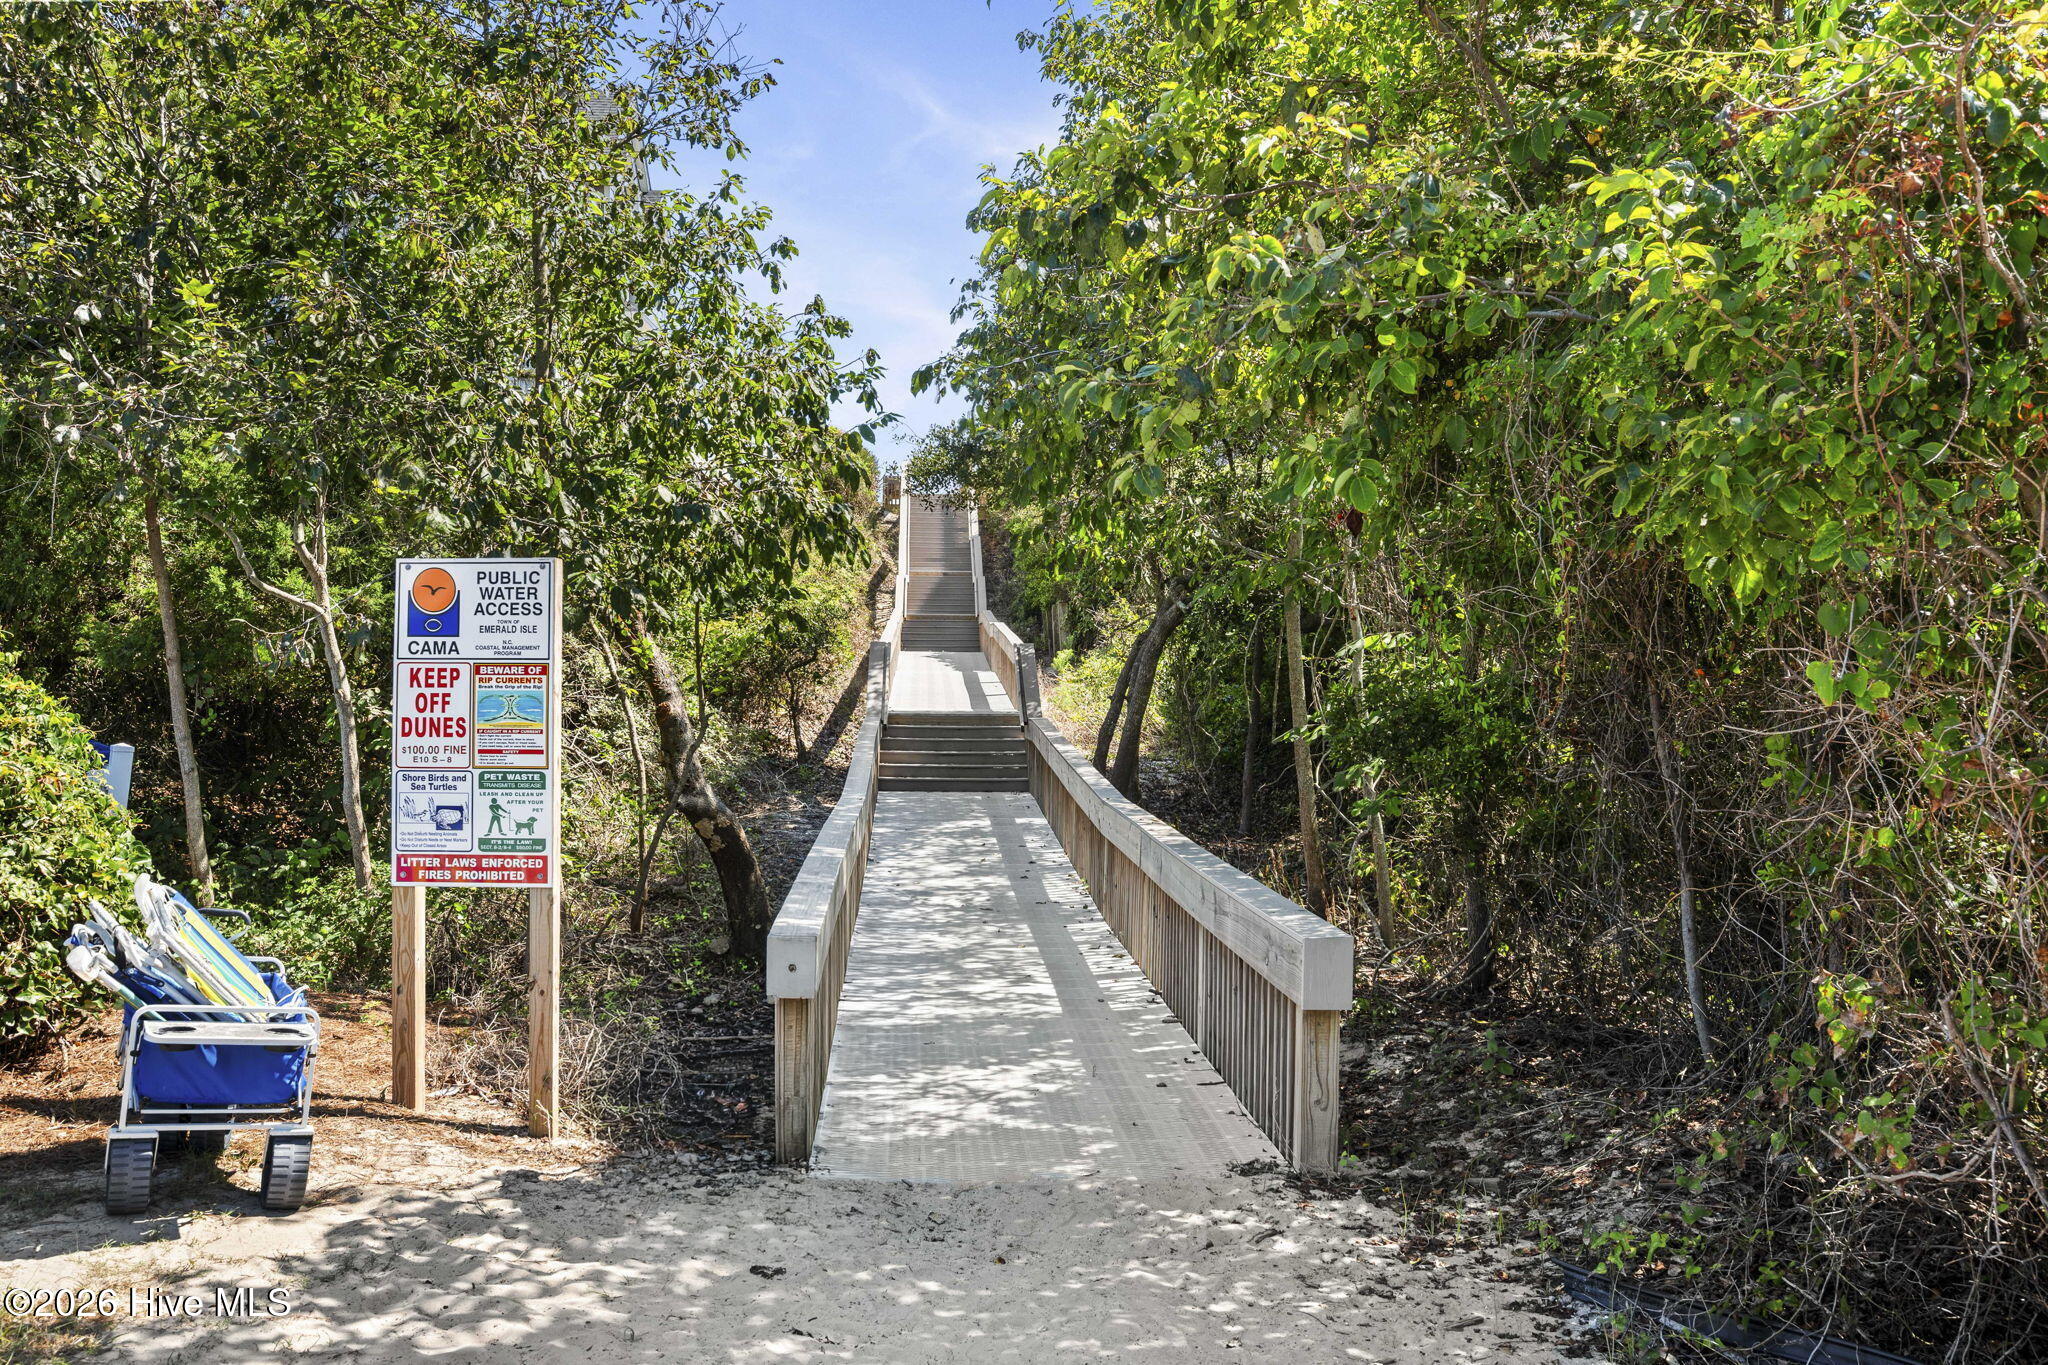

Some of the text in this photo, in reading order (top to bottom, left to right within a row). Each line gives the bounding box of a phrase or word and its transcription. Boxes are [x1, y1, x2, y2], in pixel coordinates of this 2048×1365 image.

[476, 571, 541, 585] PUBLIC
[479, 586, 538, 600] WATER
[473, 602, 543, 616] ACCESS
[479, 625, 538, 634] EMERALD ISLE
[408, 640, 460, 655] CAMA
[479, 666, 543, 675] BEWARE OF
[409, 667, 461, 688] KEEP
[478, 676, 493, 684] RIP
[415, 692, 452, 714] OFF
[401, 717, 467, 738] DUNES
[401, 745, 467, 755] $100.00 FINE
[402, 773, 467, 782] Shore Birds and
[484, 773, 541, 781] PET WASTE
[410, 782, 458, 791] Sea Turtles
[400, 857, 544, 869] LITTER LAWS ENFORCED
[418, 870, 525, 881] FIRES PROHIBITED
